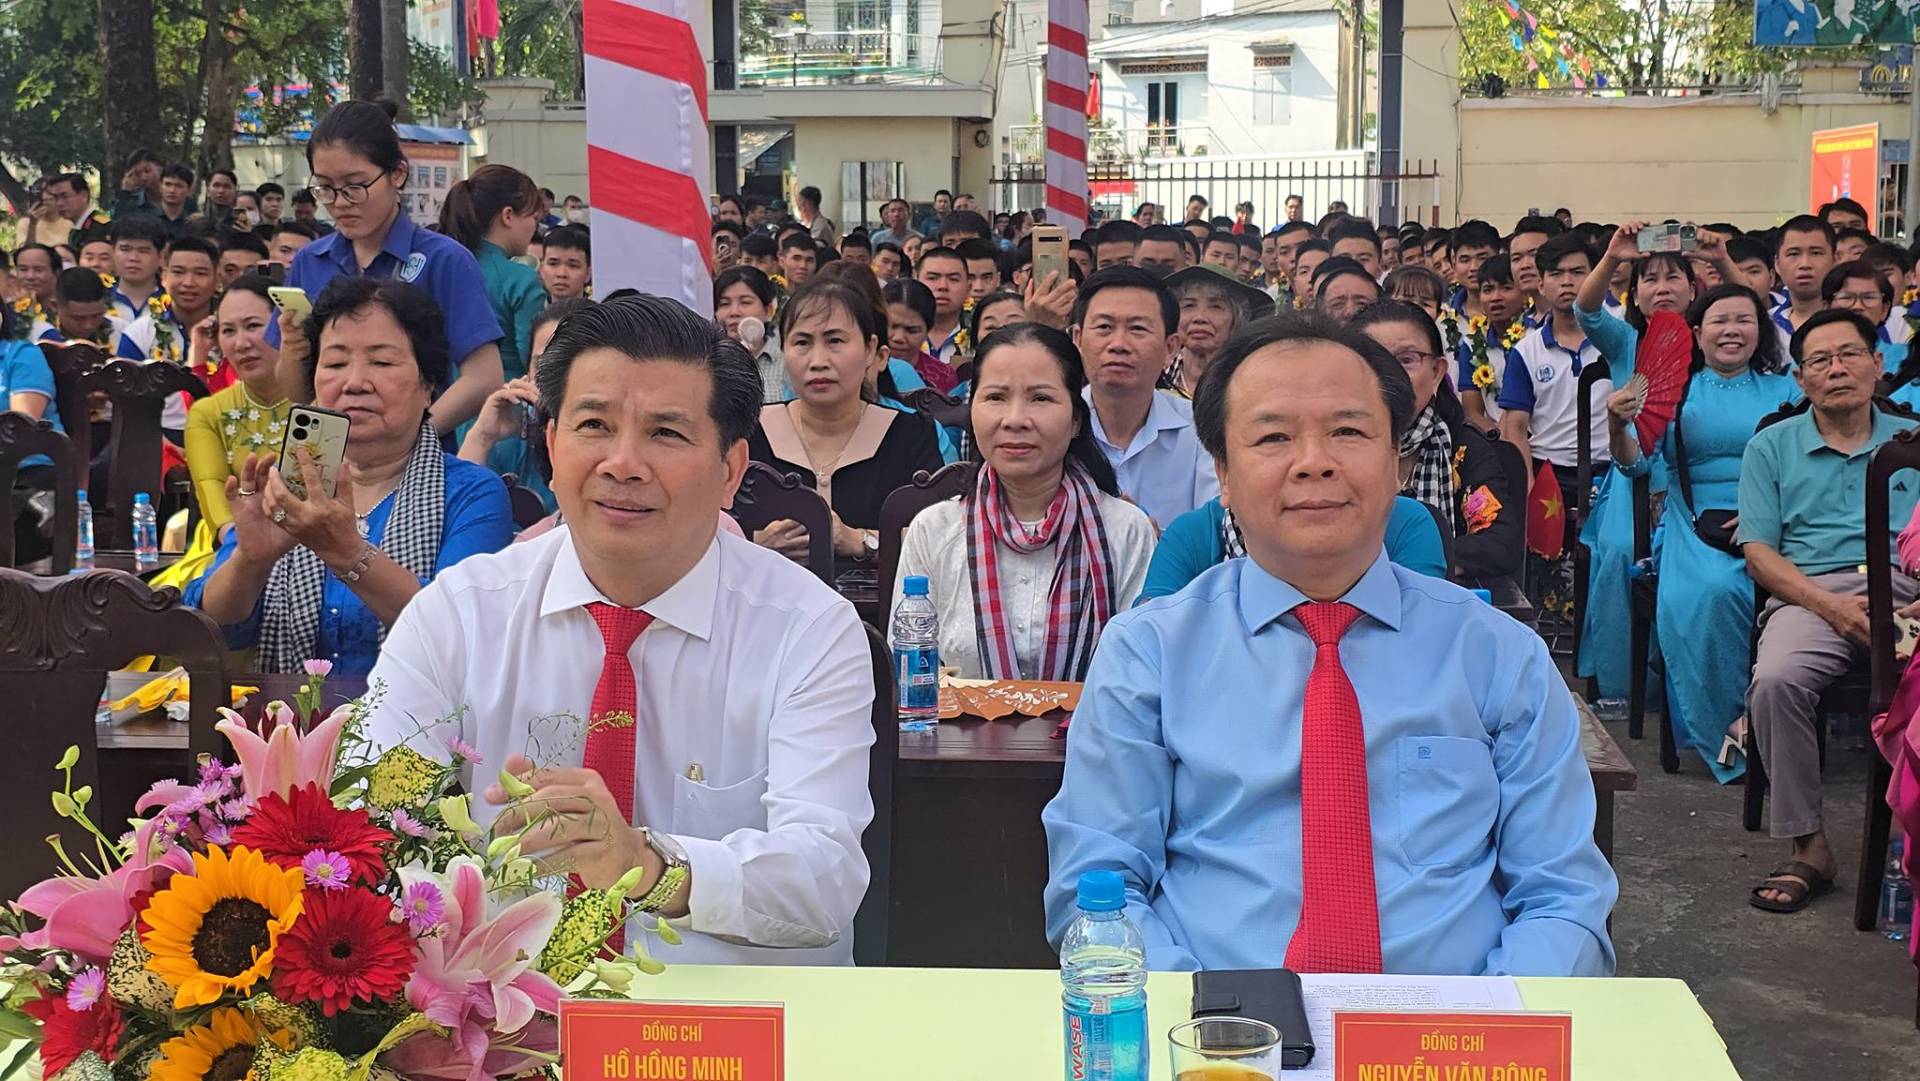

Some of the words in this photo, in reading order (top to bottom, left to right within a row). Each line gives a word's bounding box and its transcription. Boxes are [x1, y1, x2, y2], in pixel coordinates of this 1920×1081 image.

[642, 1020, 677, 1041] ĐỒNG
[681, 1023, 703, 1042] CHÍ
[1421, 1030, 1457, 1051] ĐỒNG
[1461, 1032, 1485, 1052] CHÍ
[1070, 1014, 1085, 1080] WASE
[603, 1047, 630, 1079] HỒ
[635, 1048, 687, 1080] HỒNG
[692, 1056, 743, 1081] MINH
[1358, 1057, 1439, 1081] NGUYỄN
[1444, 1061, 1486, 1081] VĂN
[1491, 1062, 1547, 1081] ĐÔNG
